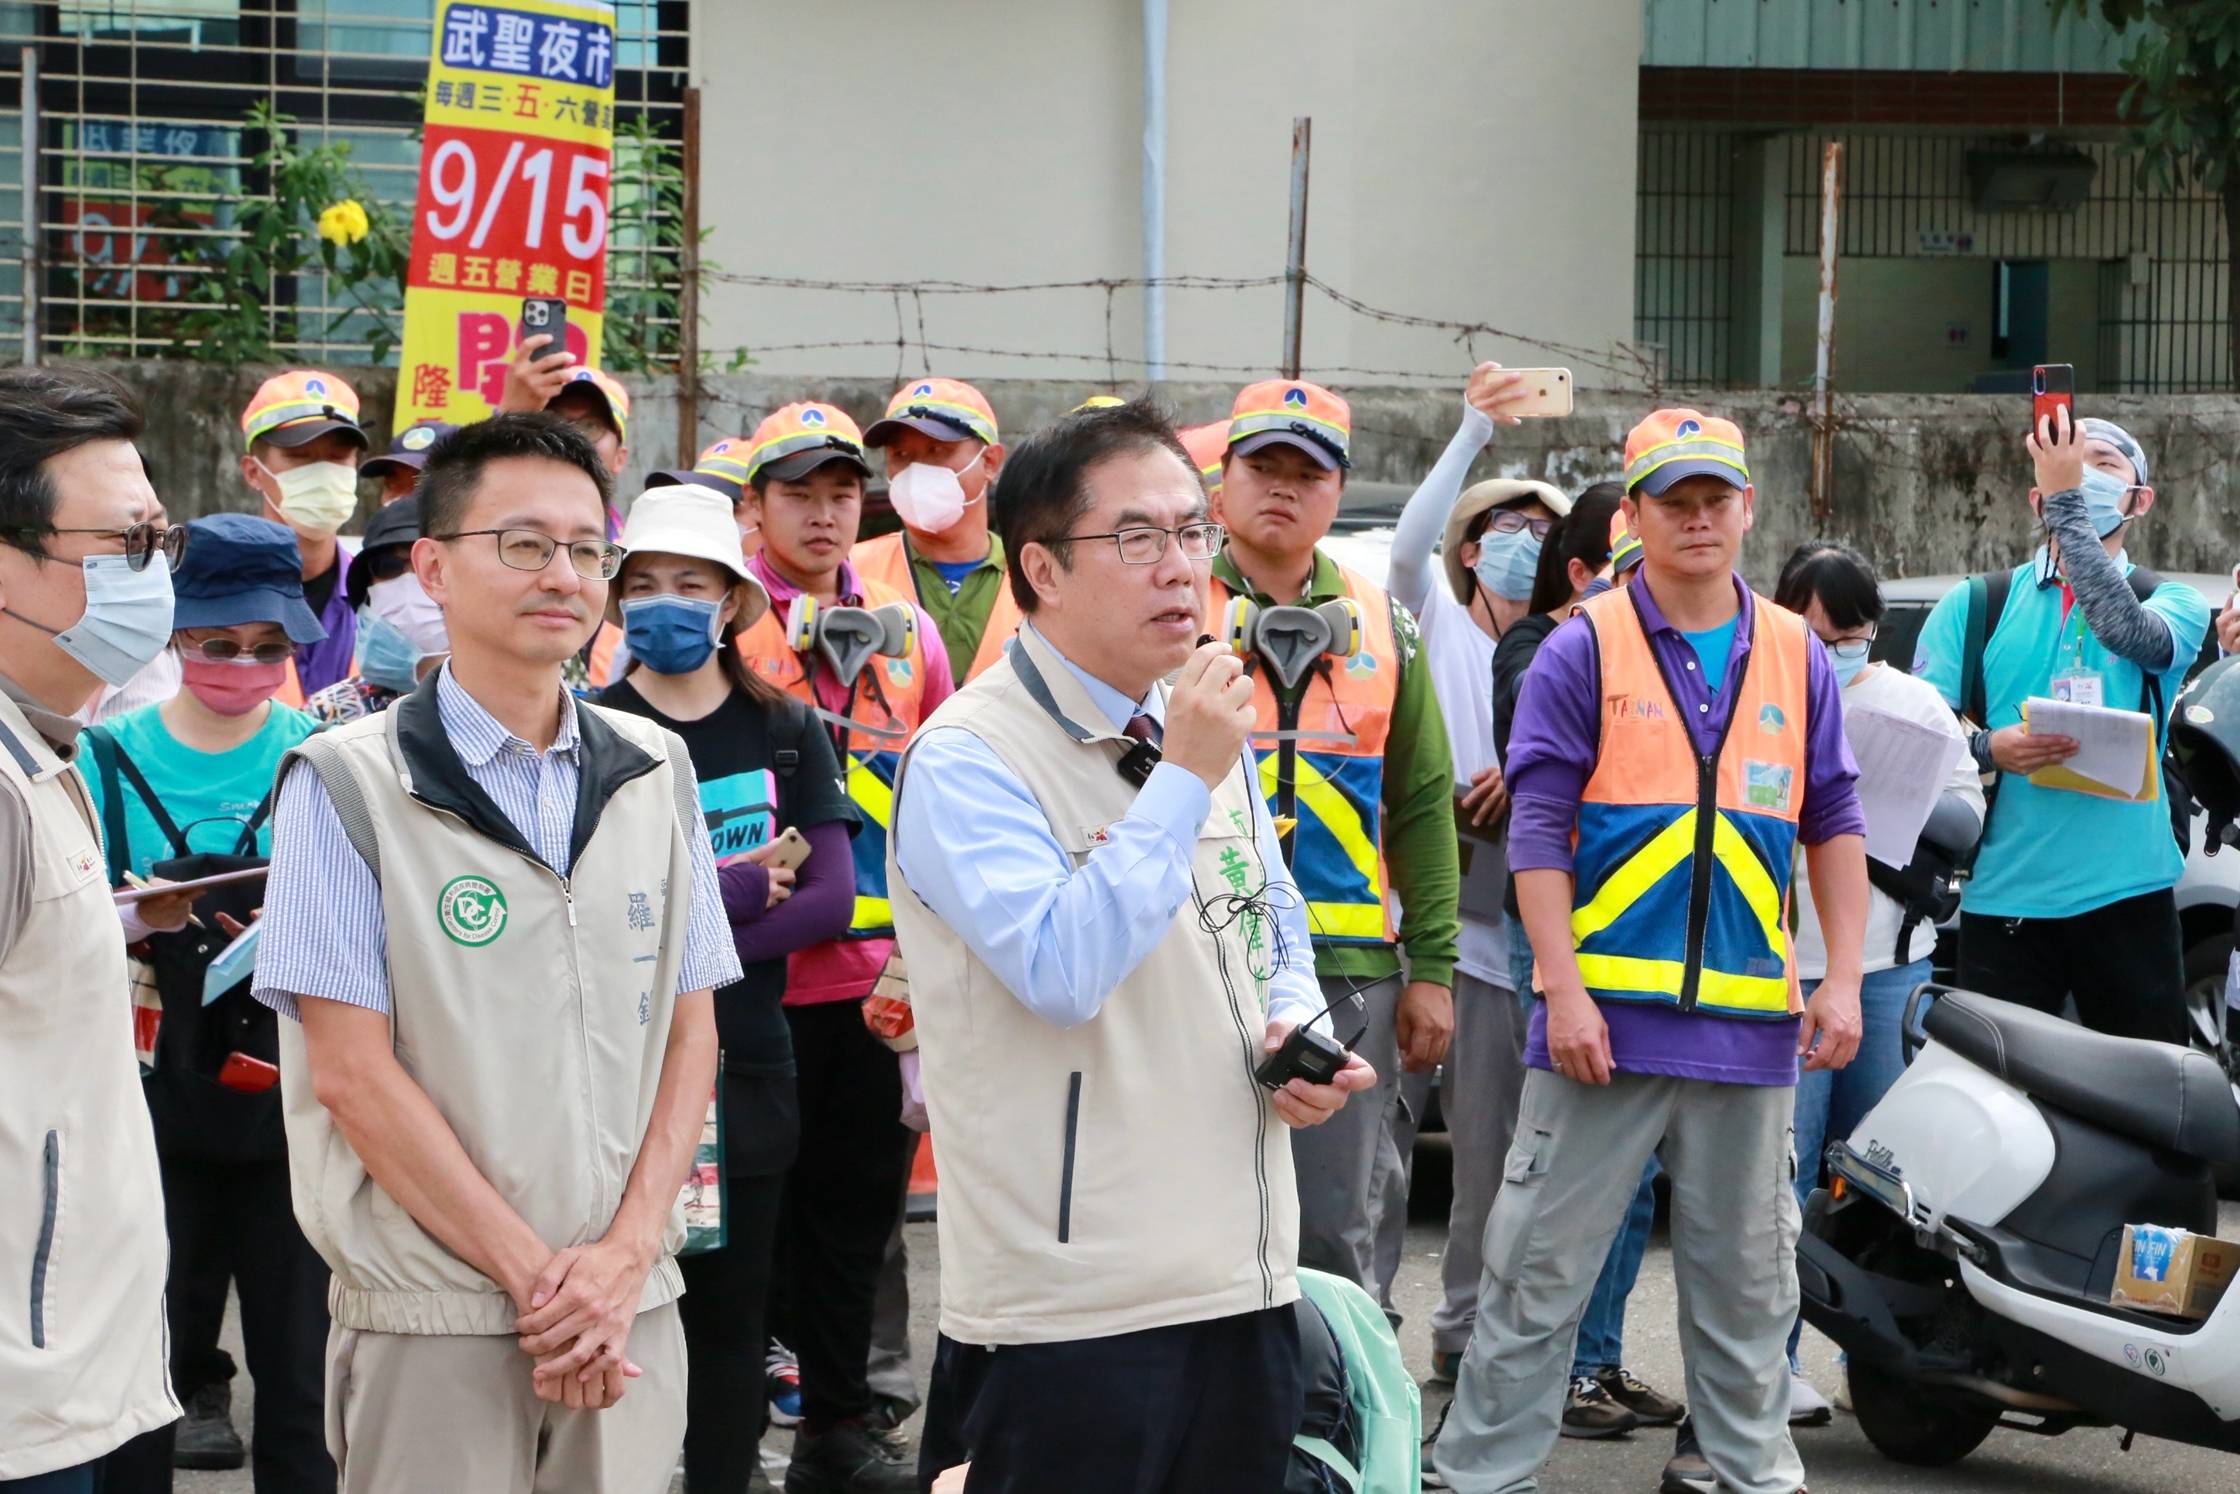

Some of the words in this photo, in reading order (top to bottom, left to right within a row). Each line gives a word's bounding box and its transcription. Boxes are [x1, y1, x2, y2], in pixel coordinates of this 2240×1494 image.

[426, 139, 608, 260] 9/15
[428, 253, 592, 303] 週五營業日
